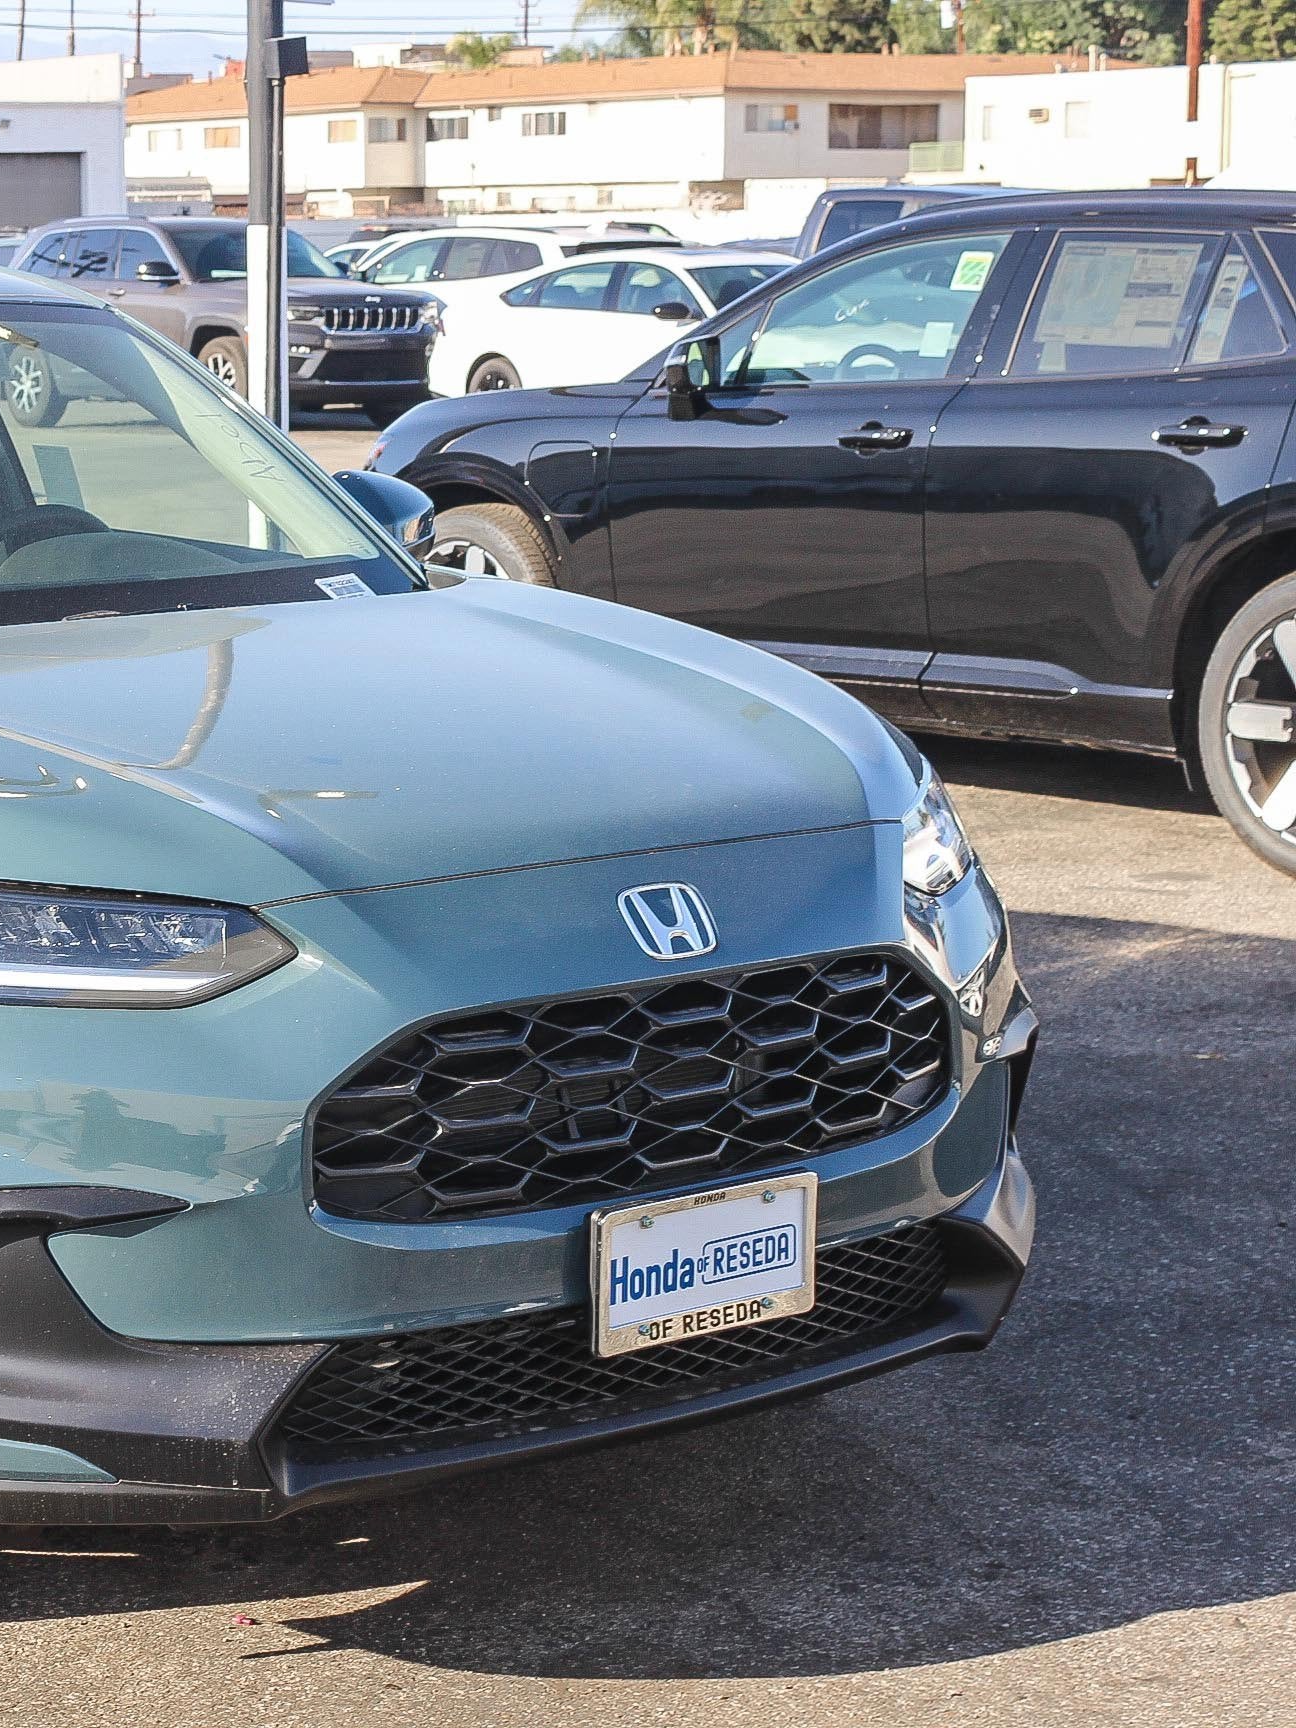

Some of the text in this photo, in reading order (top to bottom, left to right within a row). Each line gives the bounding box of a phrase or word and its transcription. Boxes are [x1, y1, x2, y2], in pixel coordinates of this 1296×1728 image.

[693, 1191, 726, 1206] HONDA
[610, 1232, 789, 1306] Honda OF RESEDA
[649, 1299, 763, 1341] OF RESEDA
